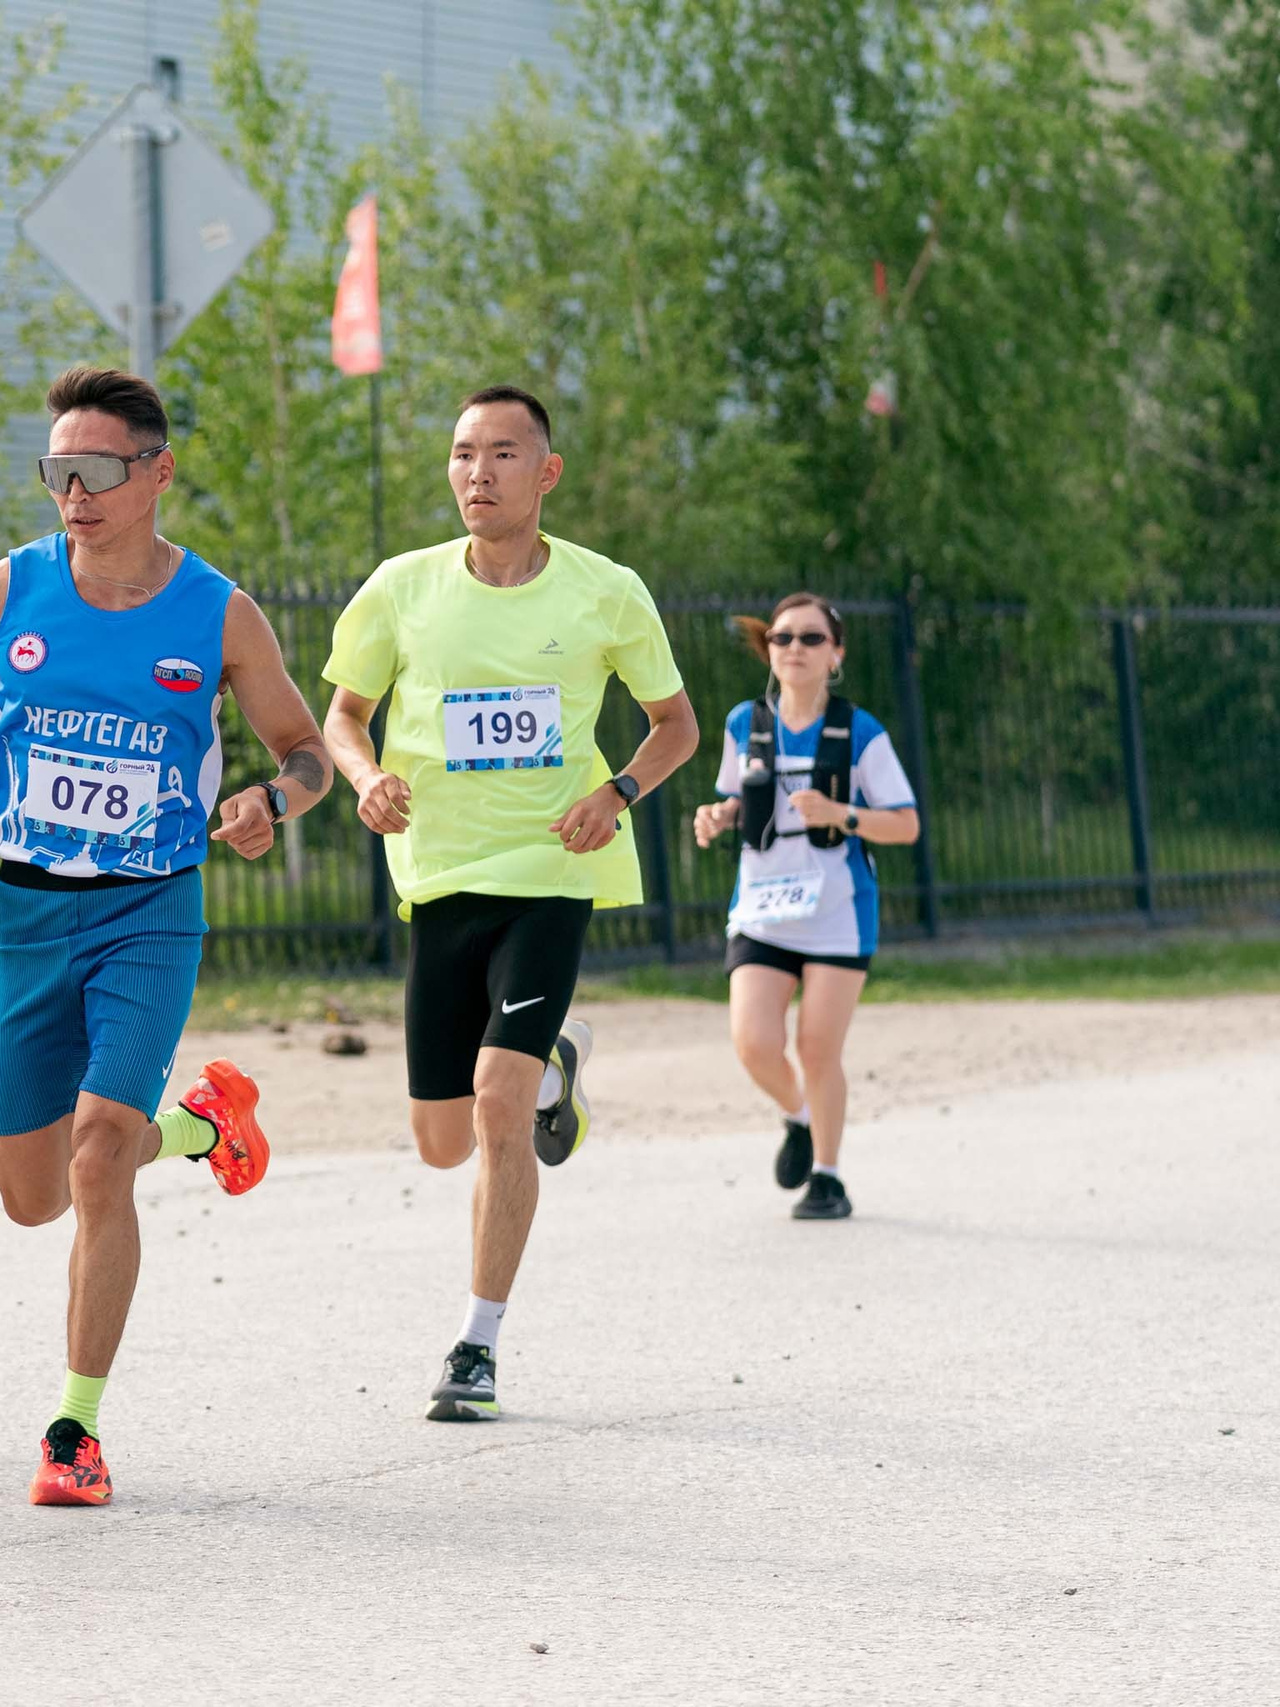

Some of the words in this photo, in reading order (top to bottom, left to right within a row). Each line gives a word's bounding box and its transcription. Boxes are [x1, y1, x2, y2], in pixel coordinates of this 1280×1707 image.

[24, 705, 169, 755] НЕФТЕГАЗ
[467, 710, 538, 745] 199
[51, 775, 129, 820] 078
